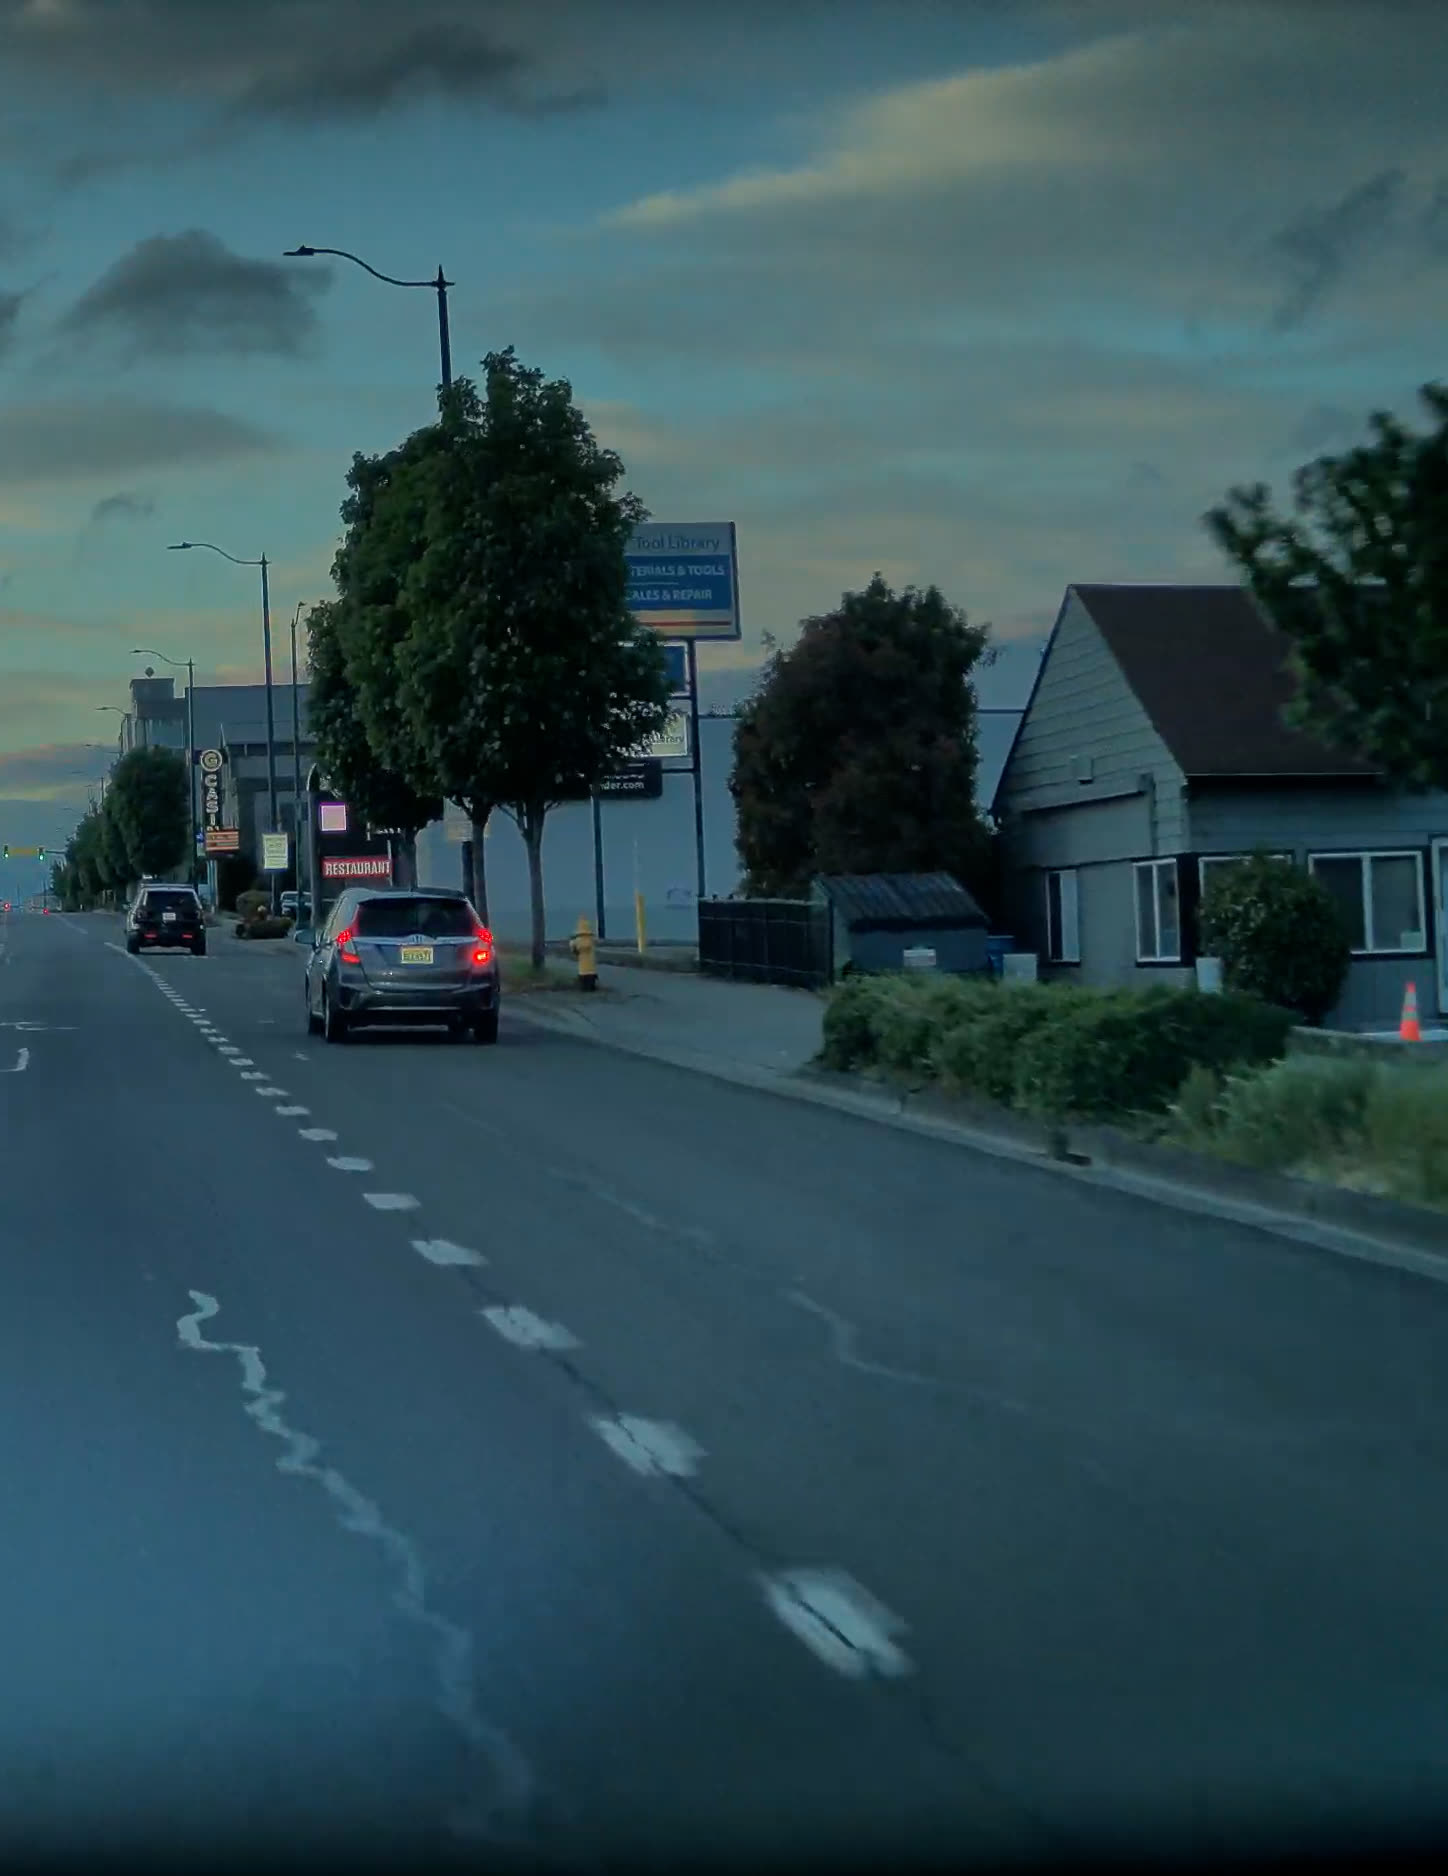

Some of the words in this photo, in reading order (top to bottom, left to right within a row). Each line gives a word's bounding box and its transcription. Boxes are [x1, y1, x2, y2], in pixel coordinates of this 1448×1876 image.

[636, 535, 664, 550] Tool
[668, 534, 720, 552] Library
[631, 565, 676, 577] TERIALS
[687, 564, 725, 576] TOOLS
[672, 589, 713, 601] REPAIR
[324, 860, 391, 876] RESTAURANT
